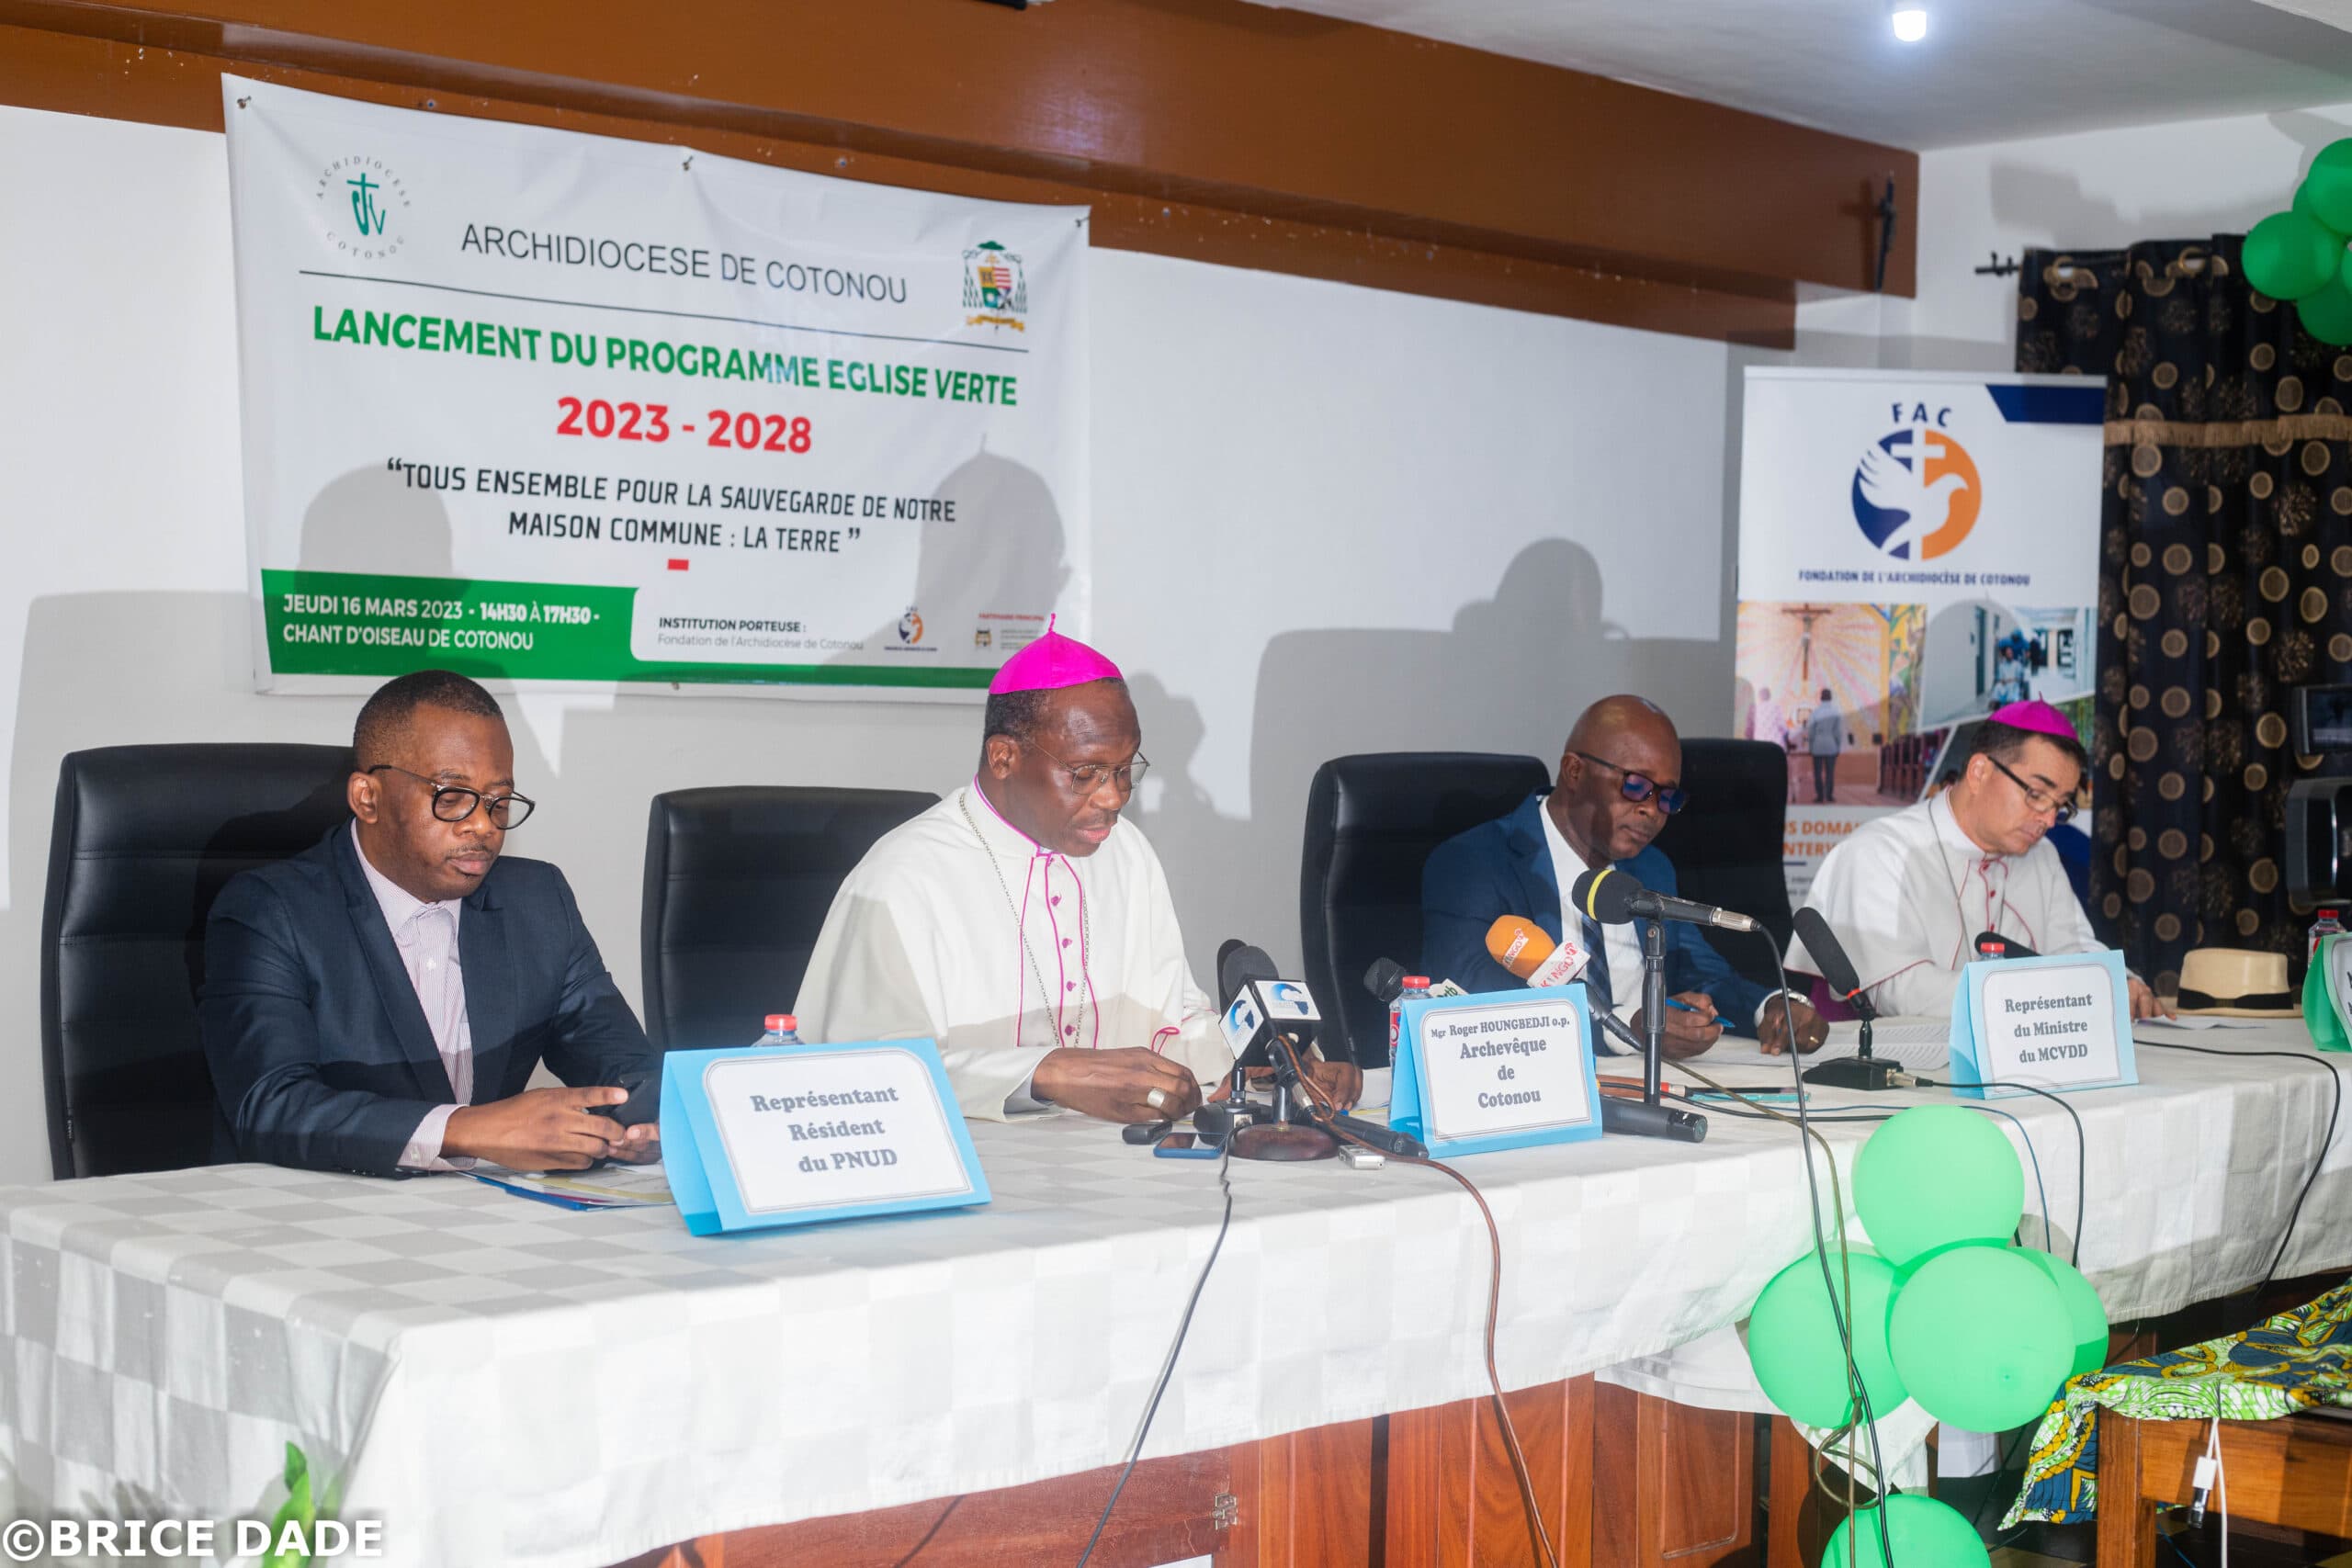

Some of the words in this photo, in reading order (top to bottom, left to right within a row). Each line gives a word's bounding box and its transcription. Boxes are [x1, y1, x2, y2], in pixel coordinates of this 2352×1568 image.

[461, 223, 710, 278] ARCHIDIOCESE
[720, 253, 756, 285] DE
[765, 261, 908, 304] COTONOU
[313, 305, 542, 361] LANCEMENT
[550, 332, 597, 367] DU
[606, 338, 820, 389] PROGRAMME
[828, 358, 928, 398] EGLISE
[935, 368, 1018, 406] VERTE
[557, 396, 671, 443] 2023
[682, 424, 695, 433] -
[707, 409, 812, 454] 2028
[1891, 401, 1951, 428] FAC
[476, 468, 608, 501] ENSEMBLE
[616, 479, 679, 505] POUR
[687, 484, 713, 508] LA
[720, 485, 856, 516] SAUVEGARDE
[862, 495, 887, 519] DE
[894, 497, 956, 522] NOTRE
[508, 512, 601, 539] MAISON
[610, 517, 722, 547] COMMUNE
[743, 525, 768, 549] LA
[775, 528, 841, 553] TERRE
[1798, 570, 1859, 582] FONDATION
[1861, 570, 1875, 583] DE
[1878, 568, 1961, 585] L'ARCHIDIOCÈSE
[1964, 572, 1977, 586] DE
[1980, 573, 2031, 586] COTONOU
[282, 593, 339, 615] JEUDI
[341, 596, 361, 616] 16
[365, 598, 418, 618] MARS
[421, 600, 463, 620] 2023
[480, 602, 527, 622] 14H30
[529, 600, 542, 623] À
[543, 604, 591, 626] 17H30
[659, 616, 736, 631] INSTITUTION
[739, 620, 801, 633] PORTEUSE
[283, 624, 343, 645] CHANT
[345, 626, 424, 648] D'OISEAU
[428, 628, 450, 649] DE
[454, 630, 534, 651] COTONOU
[658, 633, 712, 648] Fondation
[714, 635, 729, 648] de
[803, 637, 818, 649] de
[820, 638, 865, 650] Cotonou
[2004, 992, 2093, 1014] Représentant
[1430, 1028, 1447, 1040] Mgr
[1449, 1023, 1478, 1038] Roger
[1480, 1015, 1550, 1034] HOUNGBEDJI
[1552, 1017, 1570, 1028] o.p.
[2013, 1023, 2031, 1039] du
[2033, 1019, 2088, 1037] Ministre
[1460, 1037, 1547, 1059] Archevêque
[2018, 1049, 2035, 1064] du
[2037, 1044, 2088, 1062] MCVDD
[1498, 1065, 1515, 1081] de
[750, 1086, 899, 1112] Représentant
[1477, 1089, 1542, 1109] Cotonou
[787, 1118, 885, 1141] Résident
[798, 1155, 827, 1173] du
[830, 1148, 899, 1169] PNUD
